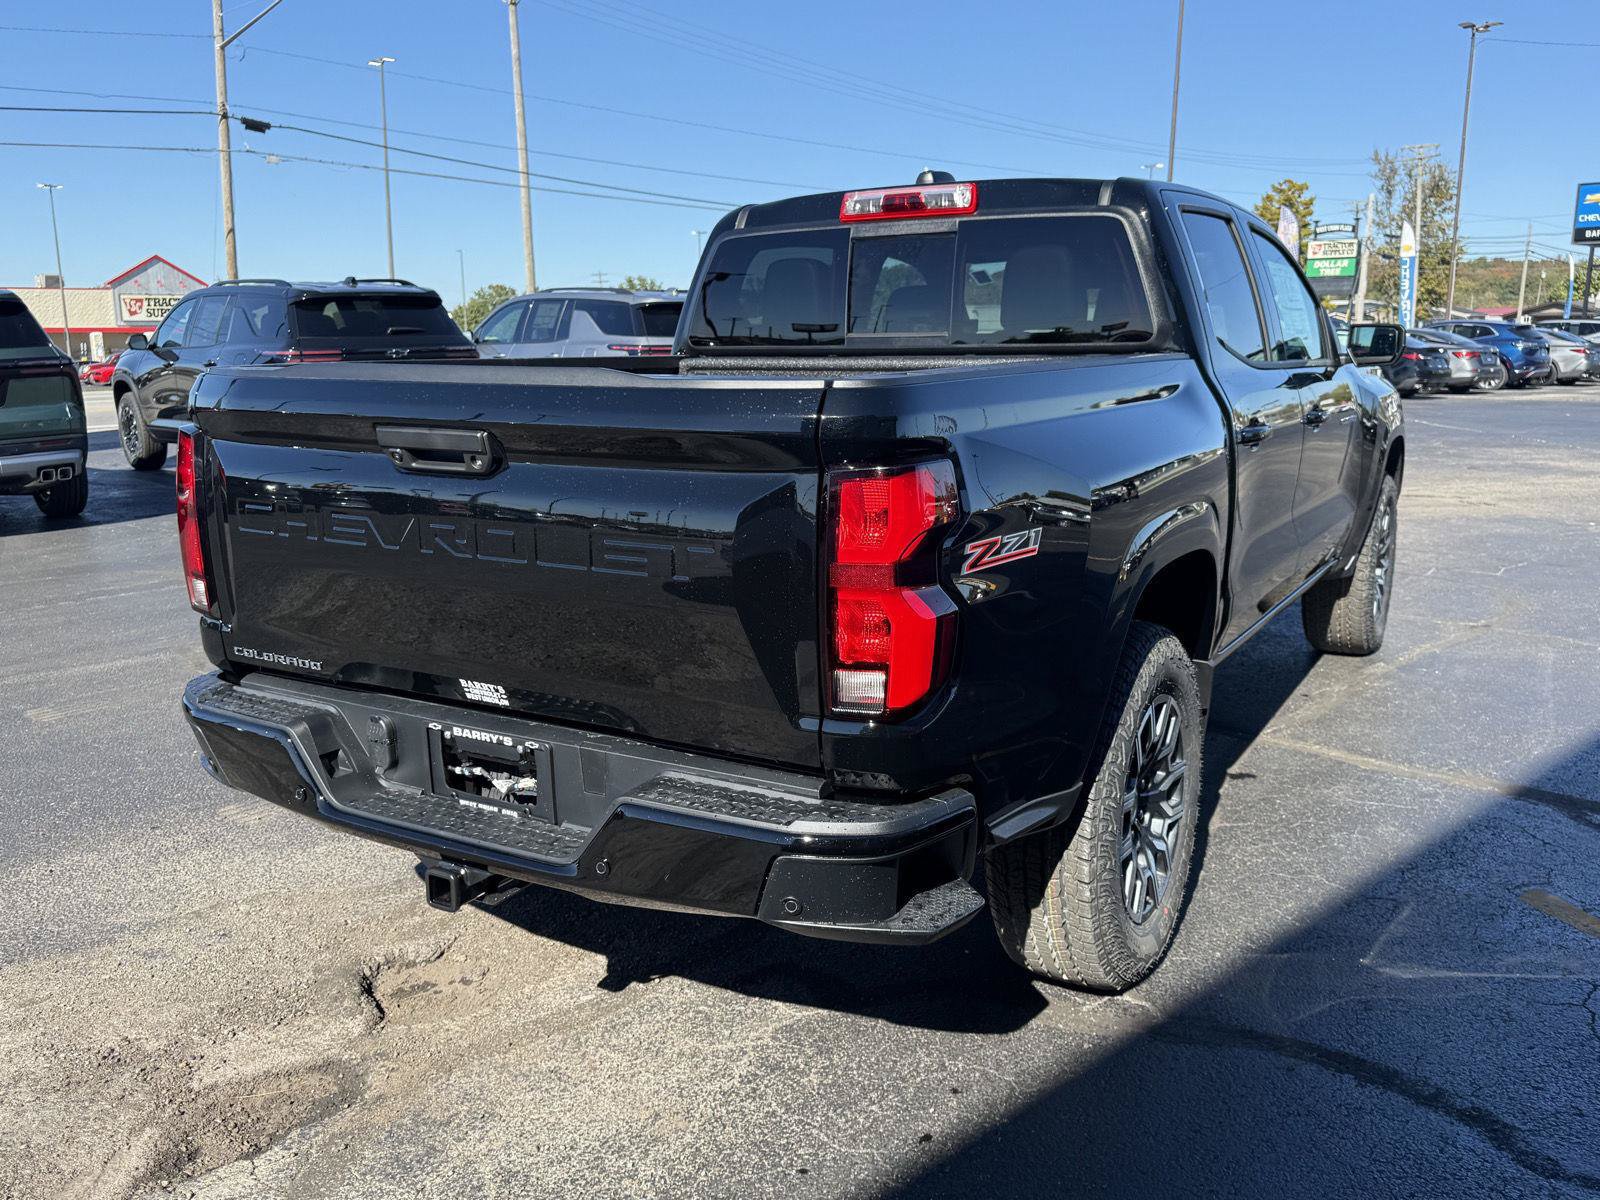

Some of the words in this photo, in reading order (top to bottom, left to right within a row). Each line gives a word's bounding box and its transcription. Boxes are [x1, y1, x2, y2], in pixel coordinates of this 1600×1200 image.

[1324, 241, 1355, 250] TRACTOR
[1313, 260, 1349, 269] DOLLAR
[146, 308, 170, 317] SUP
[235, 497, 717, 583] CHEVROLET
[960, 527, 1042, 575] Z71
[233, 646, 322, 671] COLORADO
[459, 678, 506, 694] BARRY'S
[452, 726, 513, 747] BARRY'S
